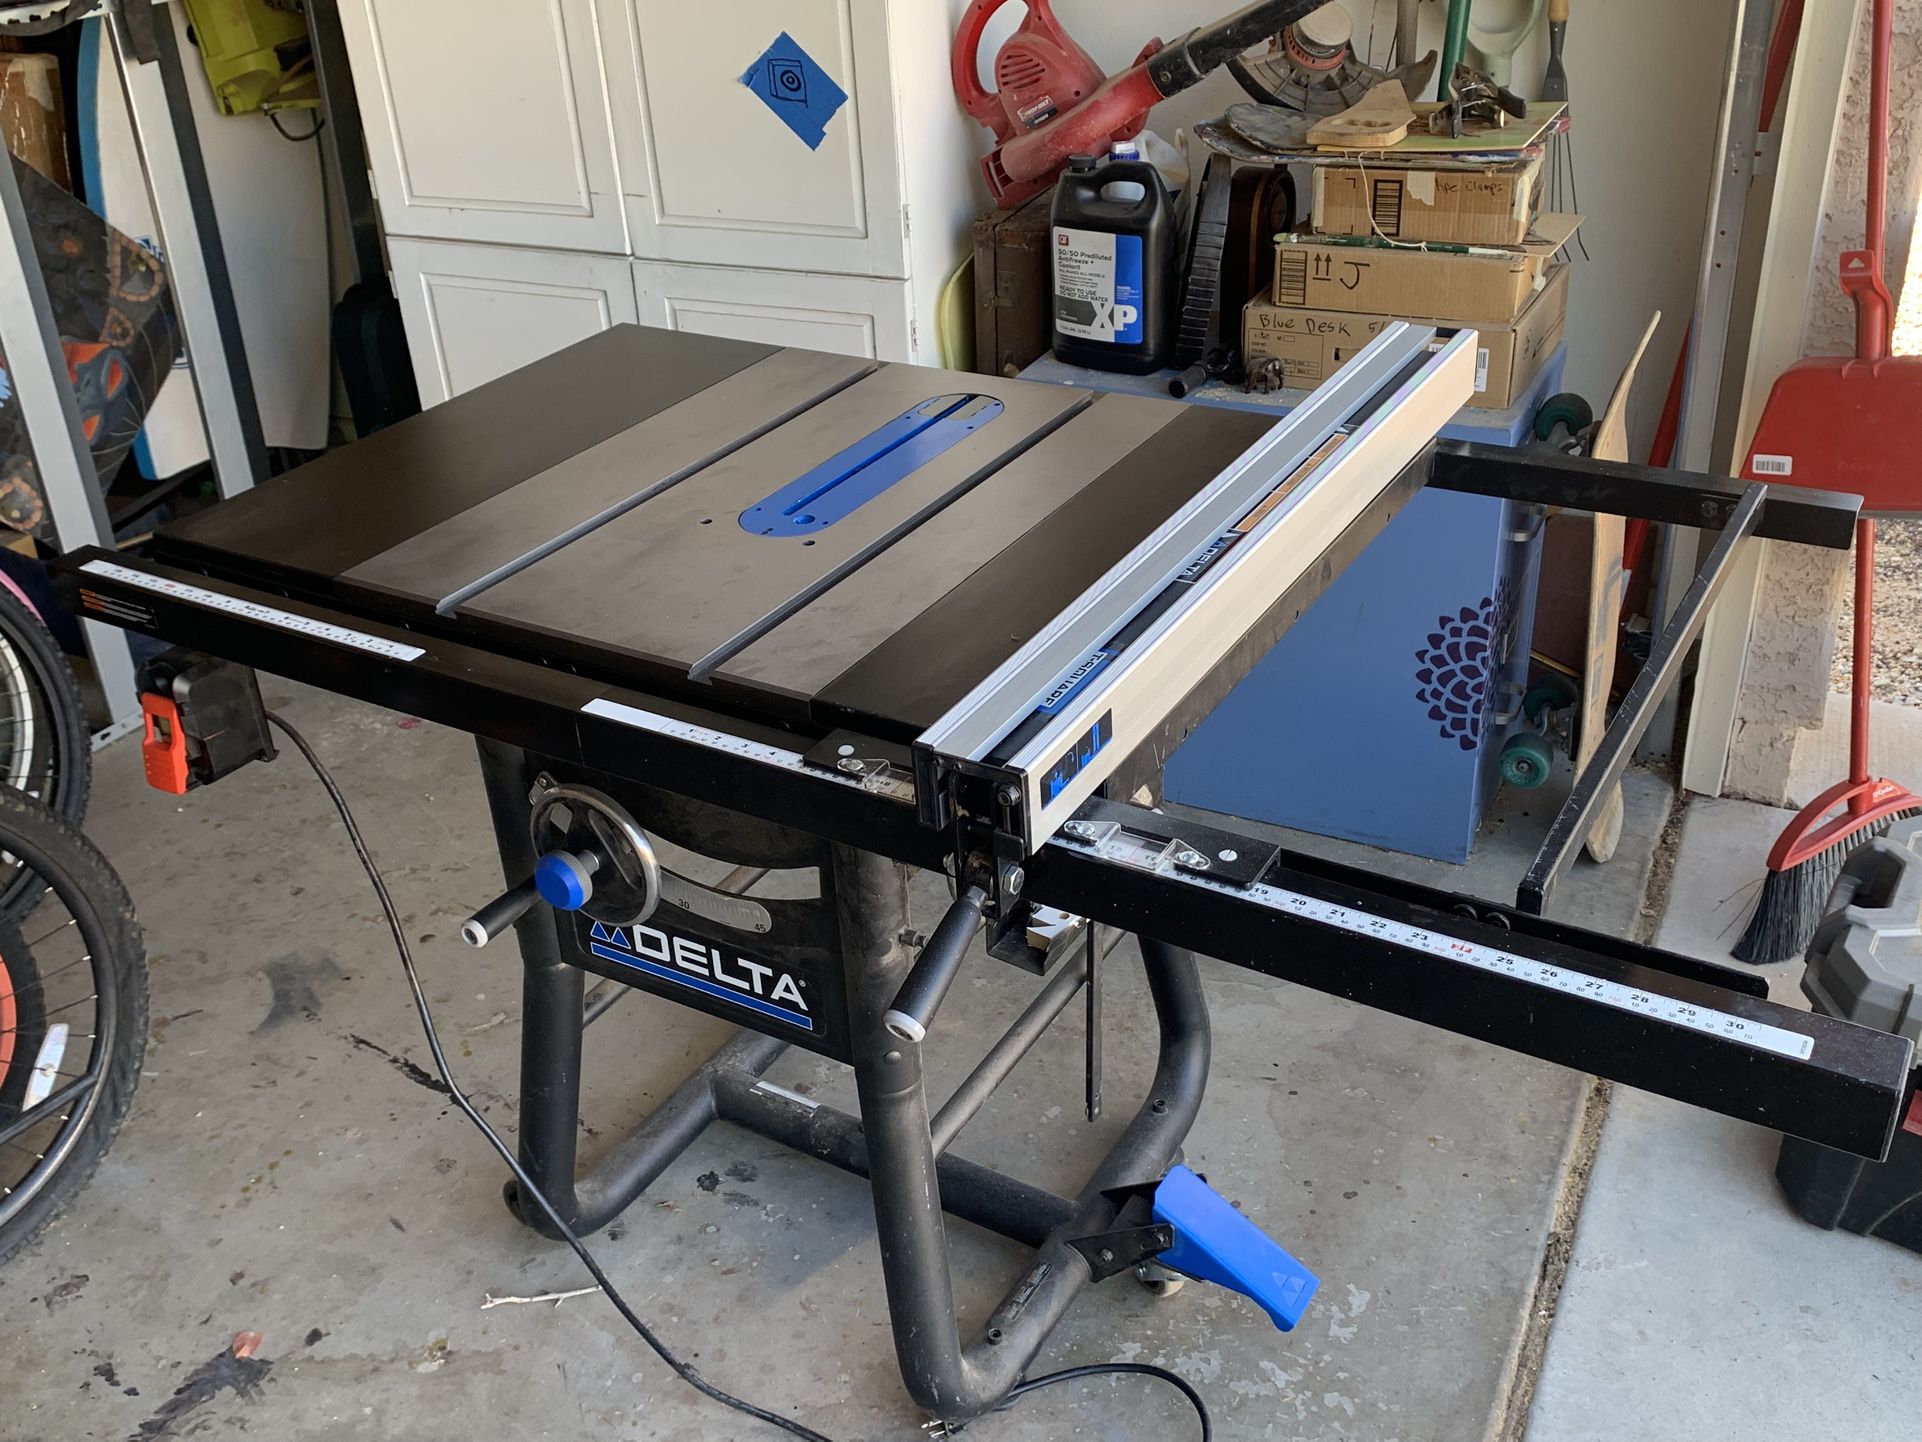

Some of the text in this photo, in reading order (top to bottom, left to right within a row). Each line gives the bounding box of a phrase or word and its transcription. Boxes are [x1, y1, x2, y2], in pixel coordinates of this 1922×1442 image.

[1058, 256, 1089, 264] Antifreeze
[1081, 251, 1112, 261] Prediluted
[1058, 262, 1081, 270] Coolant
[1091, 301, 1137, 331] XP
[1259, 313, 1295, 329] Blue
[678, 898, 690, 910] 30
[754, 923, 767, 933] 45
[633, 924, 809, 1011] DELTA
[1291, 897, 1307, 906] 20
[1330, 909, 1345, 917] 21
[1370, 920, 1387, 930] 22
[1411, 932, 1428, 941] 23
[1496, 956, 1514, 965] 25
[1540, 968, 1558, 978] 26
[1585, 981, 1603, 990] 27
[1630, 994, 1649, 1004] 28
[1677, 1006, 1697, 1017] 29
[1725, 1020, 1745, 1030] 30
